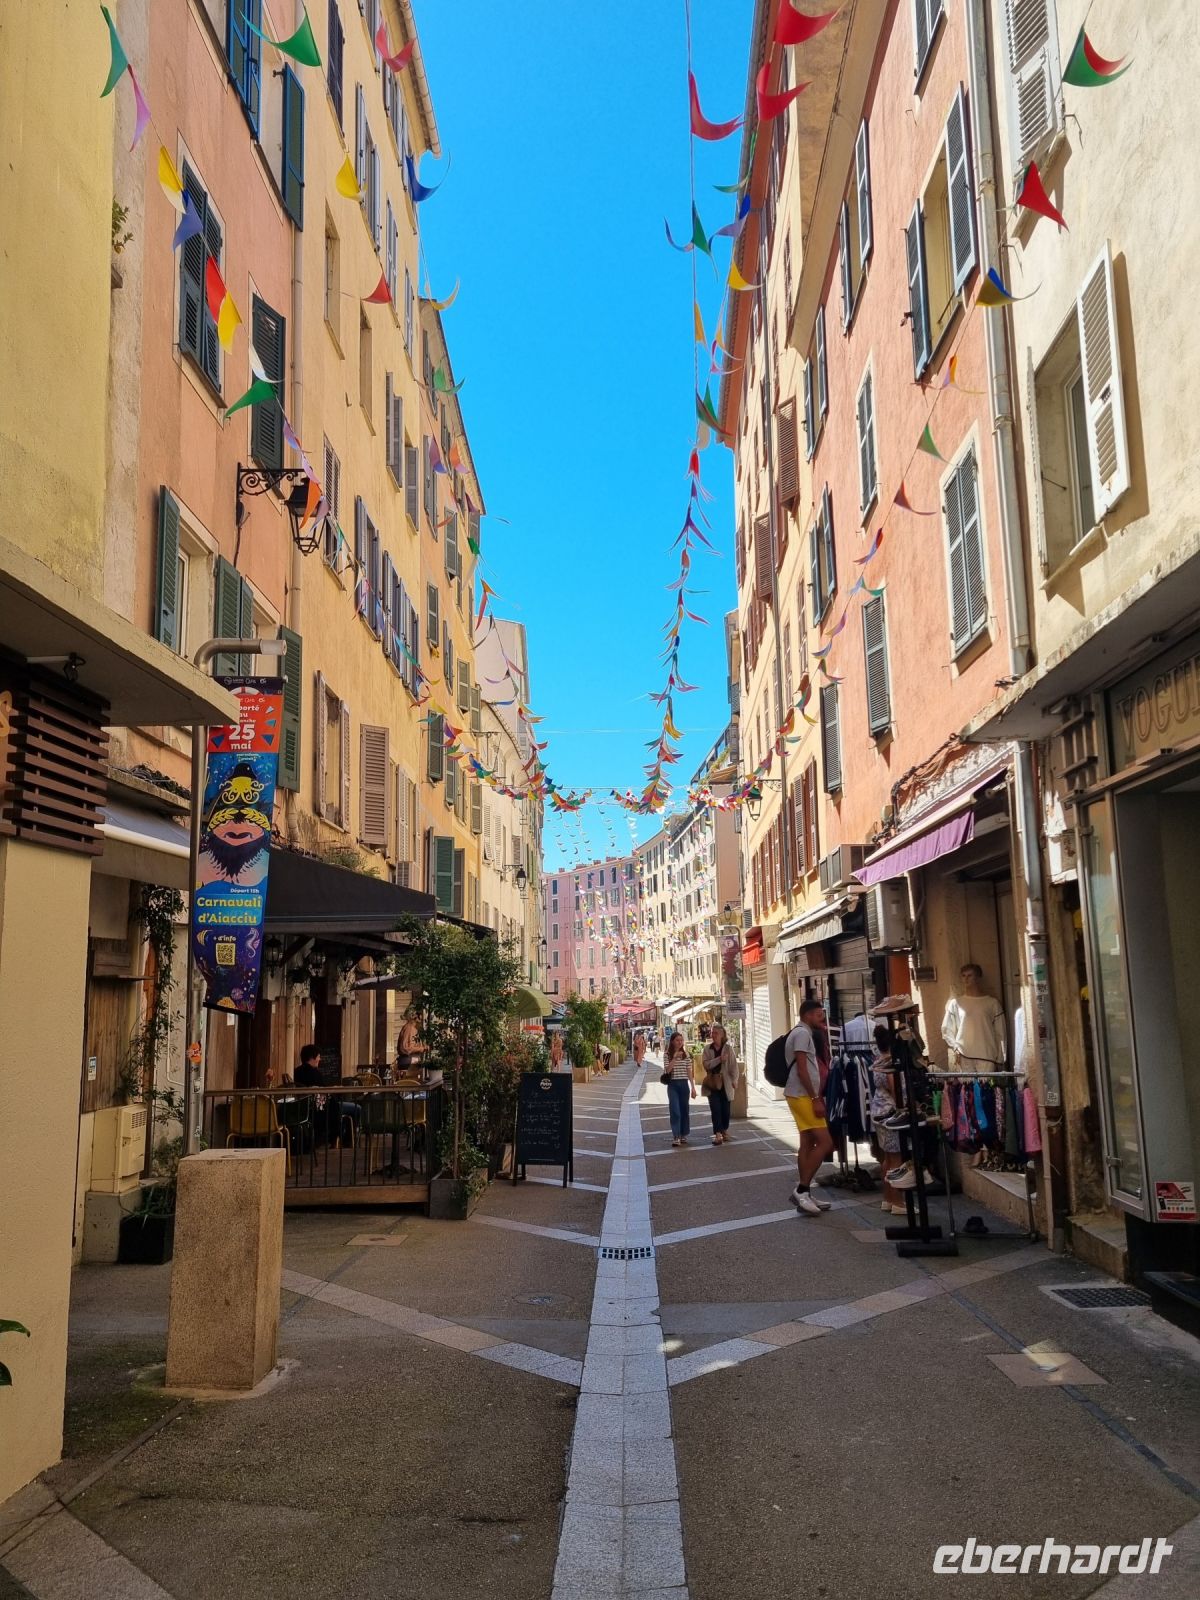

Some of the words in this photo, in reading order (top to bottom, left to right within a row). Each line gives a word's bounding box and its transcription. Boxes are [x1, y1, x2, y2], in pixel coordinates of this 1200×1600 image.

[229, 724, 255, 740] 25
[231, 741, 252, 749] mai
[197, 896, 261, 907] Carnavali
[198, 912, 256, 924] d'Aiacciu
